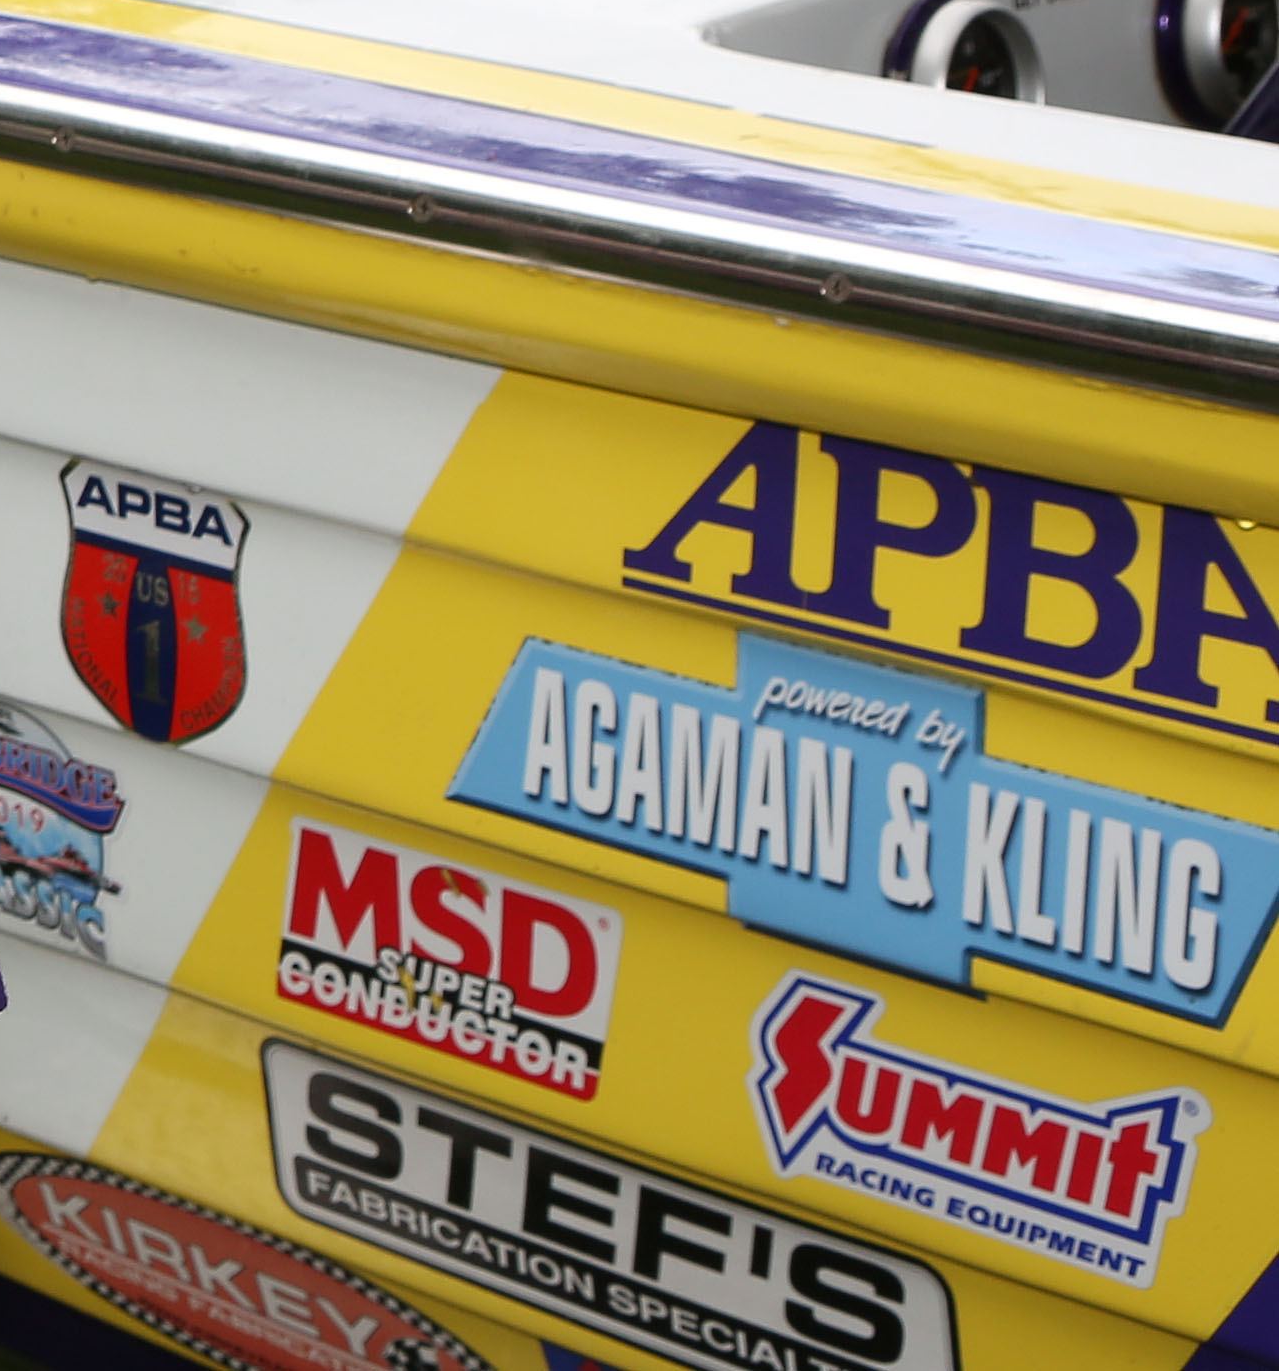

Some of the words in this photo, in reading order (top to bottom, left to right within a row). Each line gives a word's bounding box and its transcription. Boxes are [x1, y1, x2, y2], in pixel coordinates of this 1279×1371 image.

[76, 474, 235, 548] APBA
[622, 418, 1279, 728] APBA
[753, 676, 911, 736] powered
[915, 709, 966, 772] by
[523, 666, 855, 886] AGAMAN
[878, 761, 935, 909] &
[961, 781, 1223, 992] KLING
[289, 827, 599, 1019] MSD
[375, 946, 514, 1021] SUPER
[279, 950, 590, 1092] CONDUCTOR
[41, 1180, 381, 1360] KIRKEY
[305, 1072, 906, 1366] STEF'S
[307, 1169, 596, 1303] FABRICATION
[815, 1152, 935, 1209] RACING
[946, 1197, 1146, 1278] EQUIPMENT
